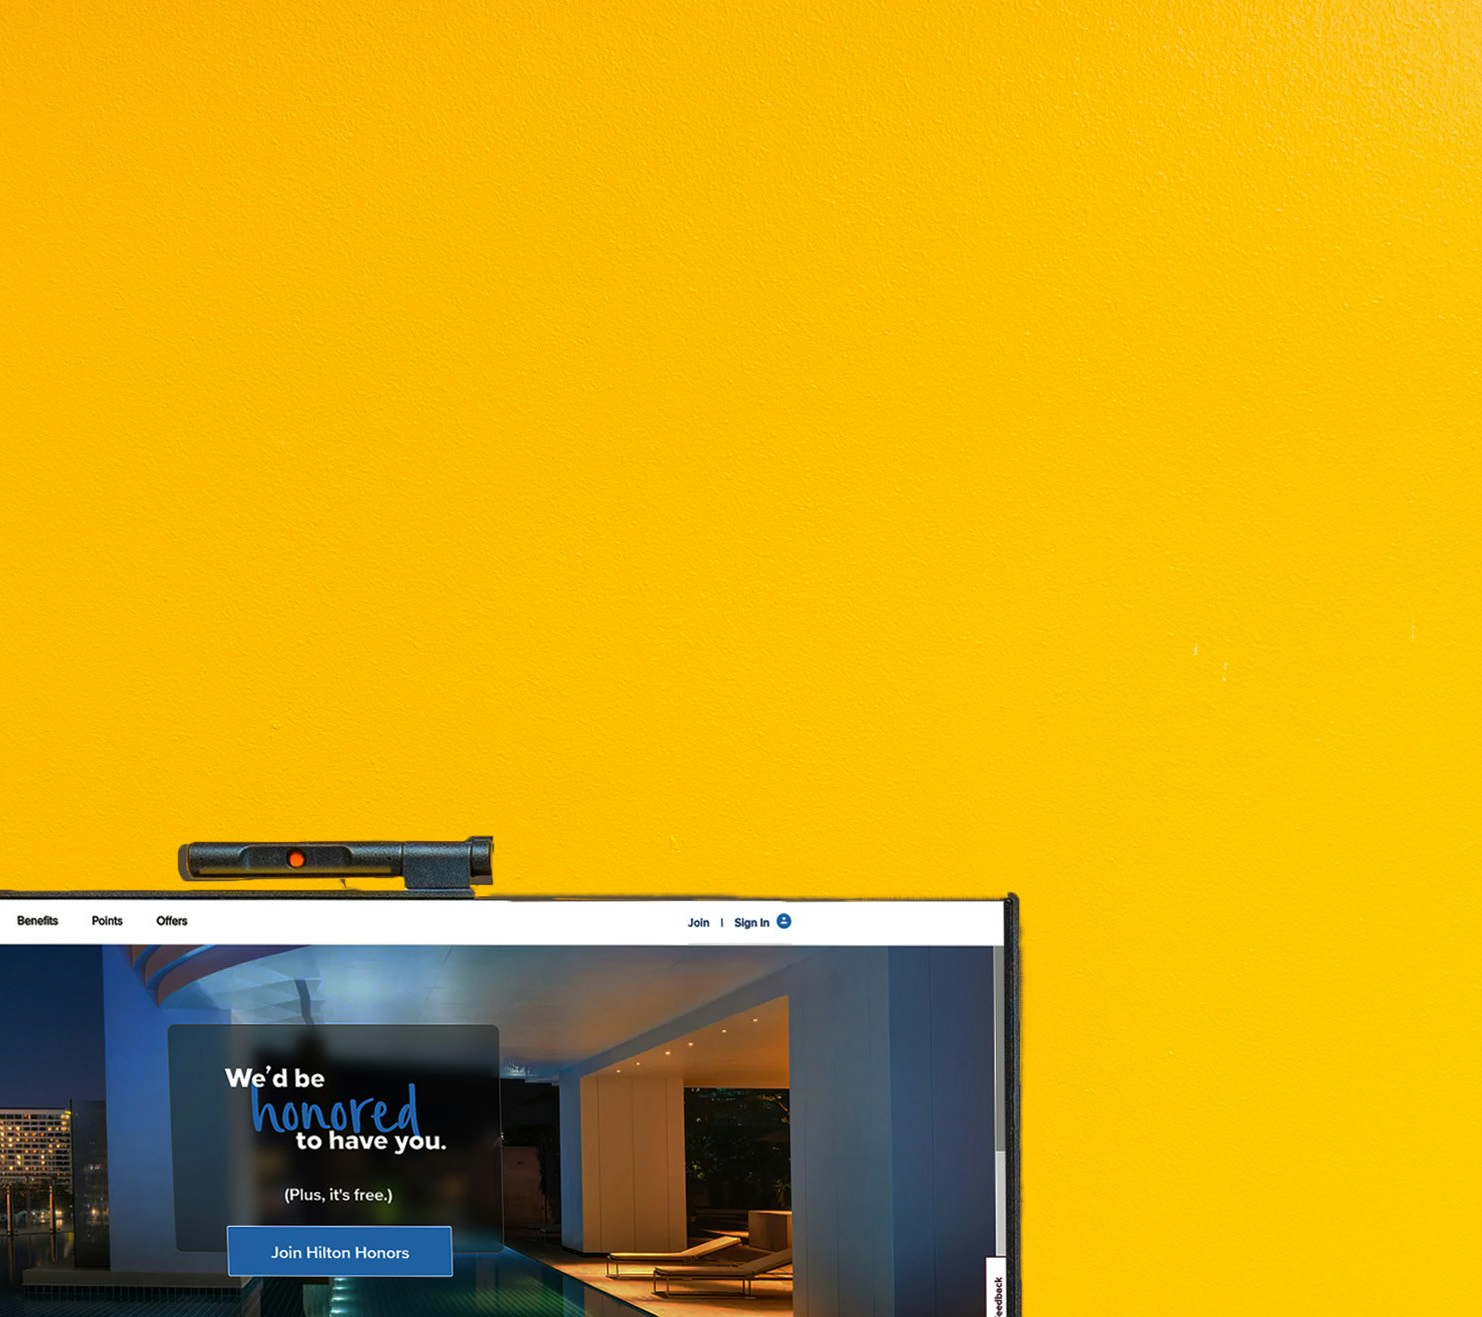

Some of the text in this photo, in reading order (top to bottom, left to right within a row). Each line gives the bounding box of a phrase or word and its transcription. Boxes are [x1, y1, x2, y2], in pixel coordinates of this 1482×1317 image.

[16, 915, 59, 926] Benefits
[91, 915, 124, 927] Points
[155, 915, 189, 927] Offers
[687, 917, 710, 928] Join
[734, 917, 770, 930] Sign In
[224, 1065, 325, 1088] We'd be
[251, 1082, 420, 1137] honored
[295, 1129, 447, 1155] to have you.
[284, 1187, 393, 1204] (Plus, it's free.)
[270, 1245, 410, 1260] Join Hilton Honors
